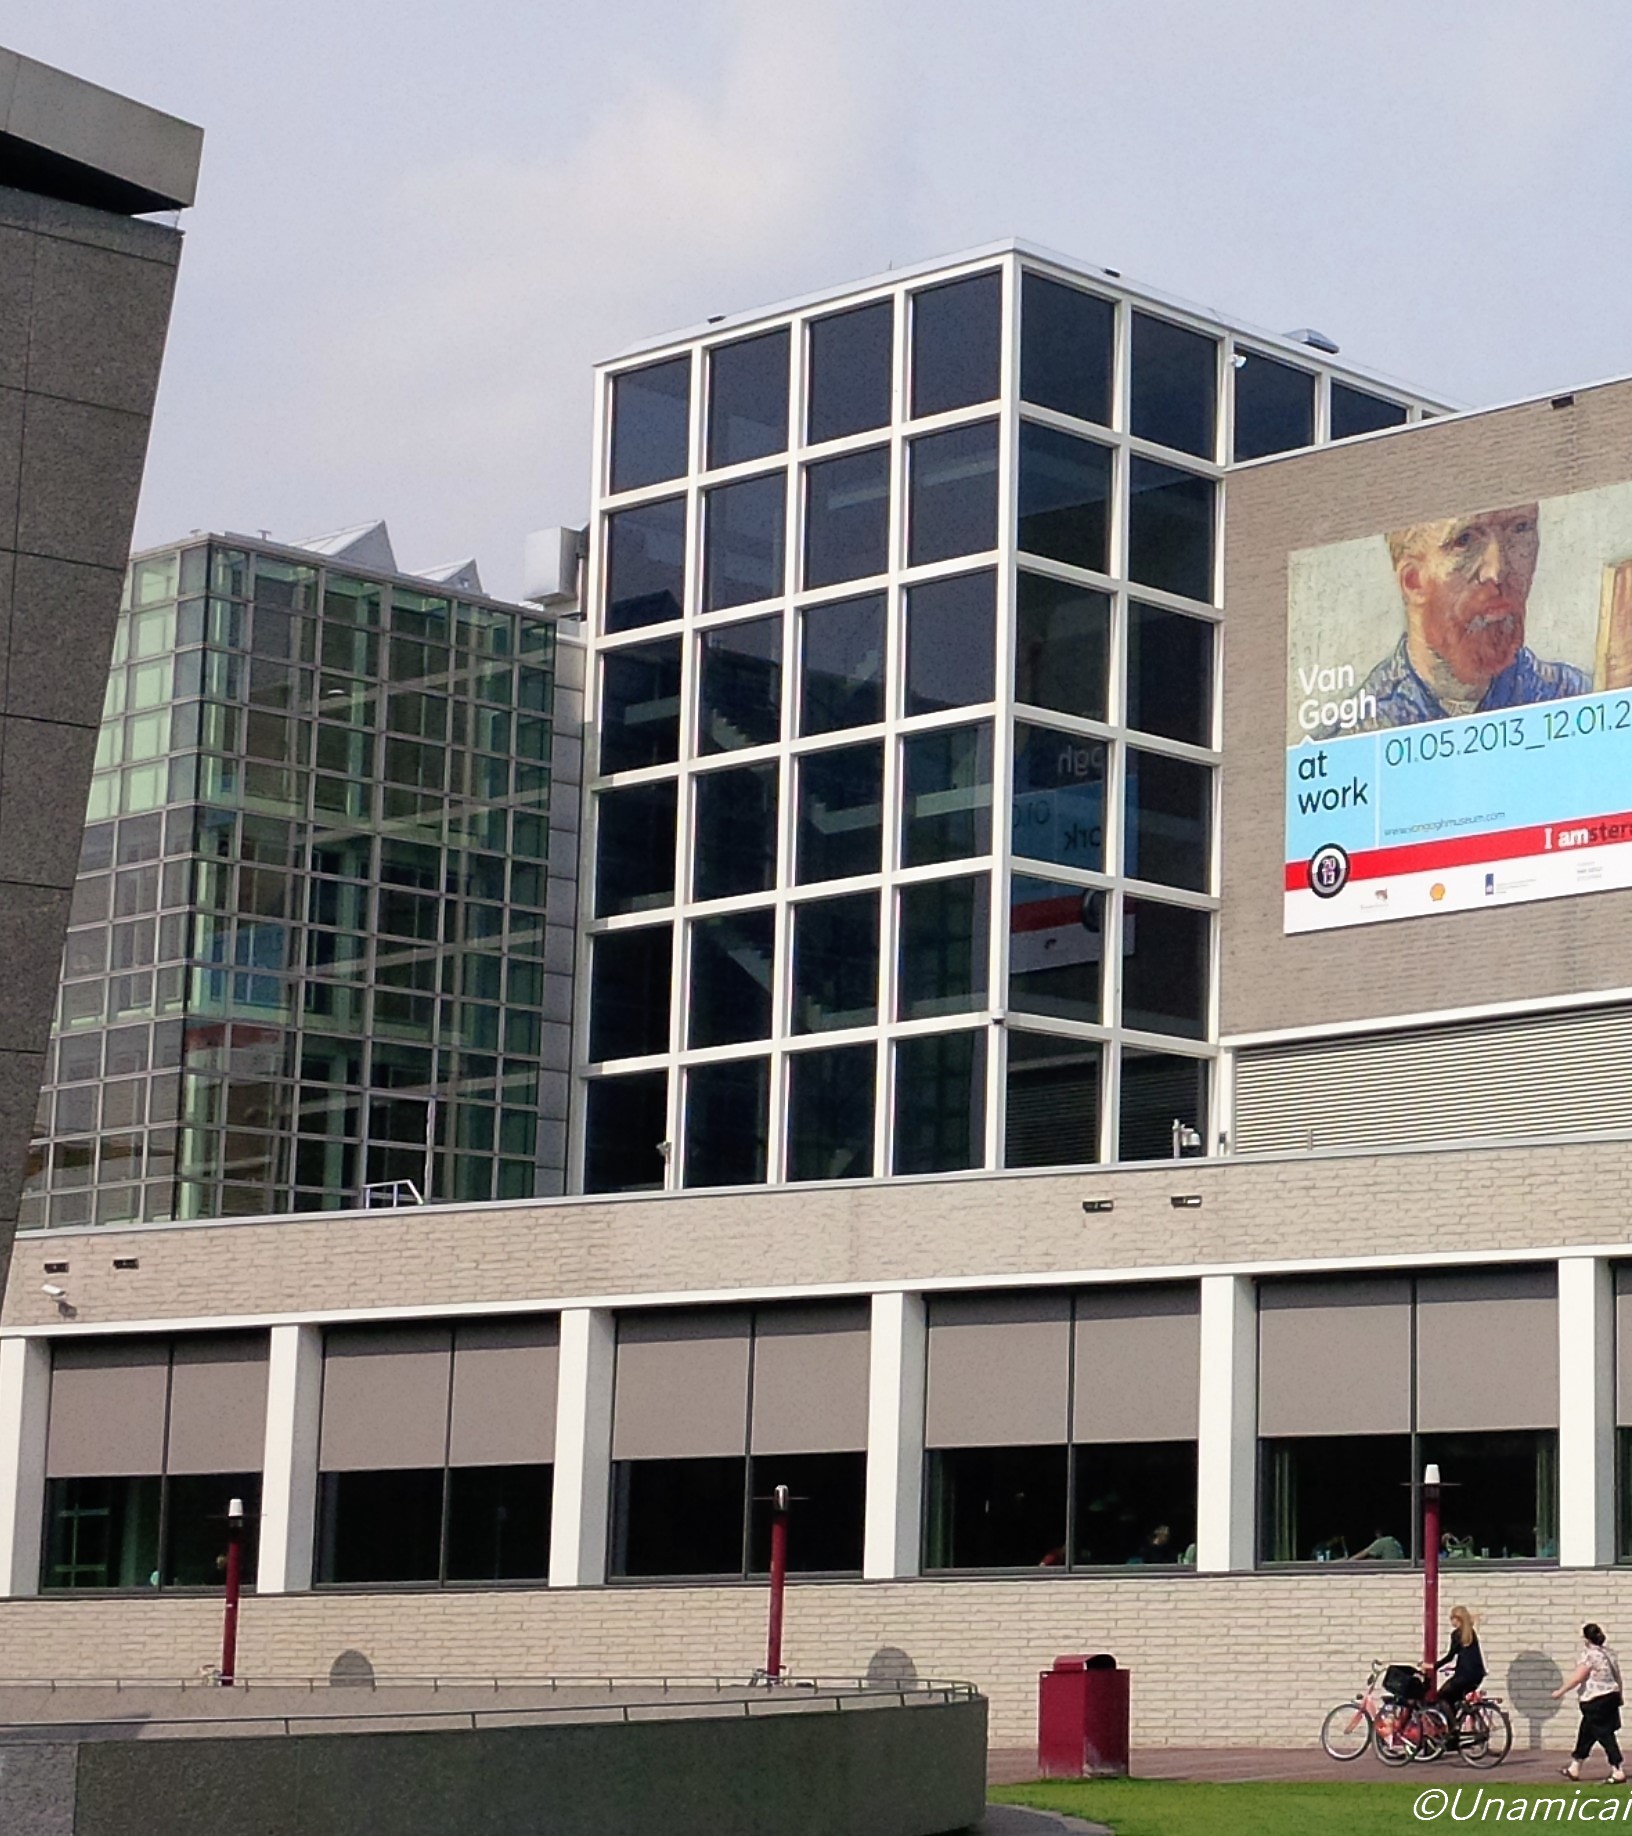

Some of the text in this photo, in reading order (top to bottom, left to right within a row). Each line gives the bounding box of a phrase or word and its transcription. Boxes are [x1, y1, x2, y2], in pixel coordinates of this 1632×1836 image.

[1298, 663, 1355, 695] Van
[1298, 687, 1377, 730] Gogh
[1298, 750, 1329, 781] at
[1297, 775, 1369, 816] work
[1544, 827, 1553, 850] I
